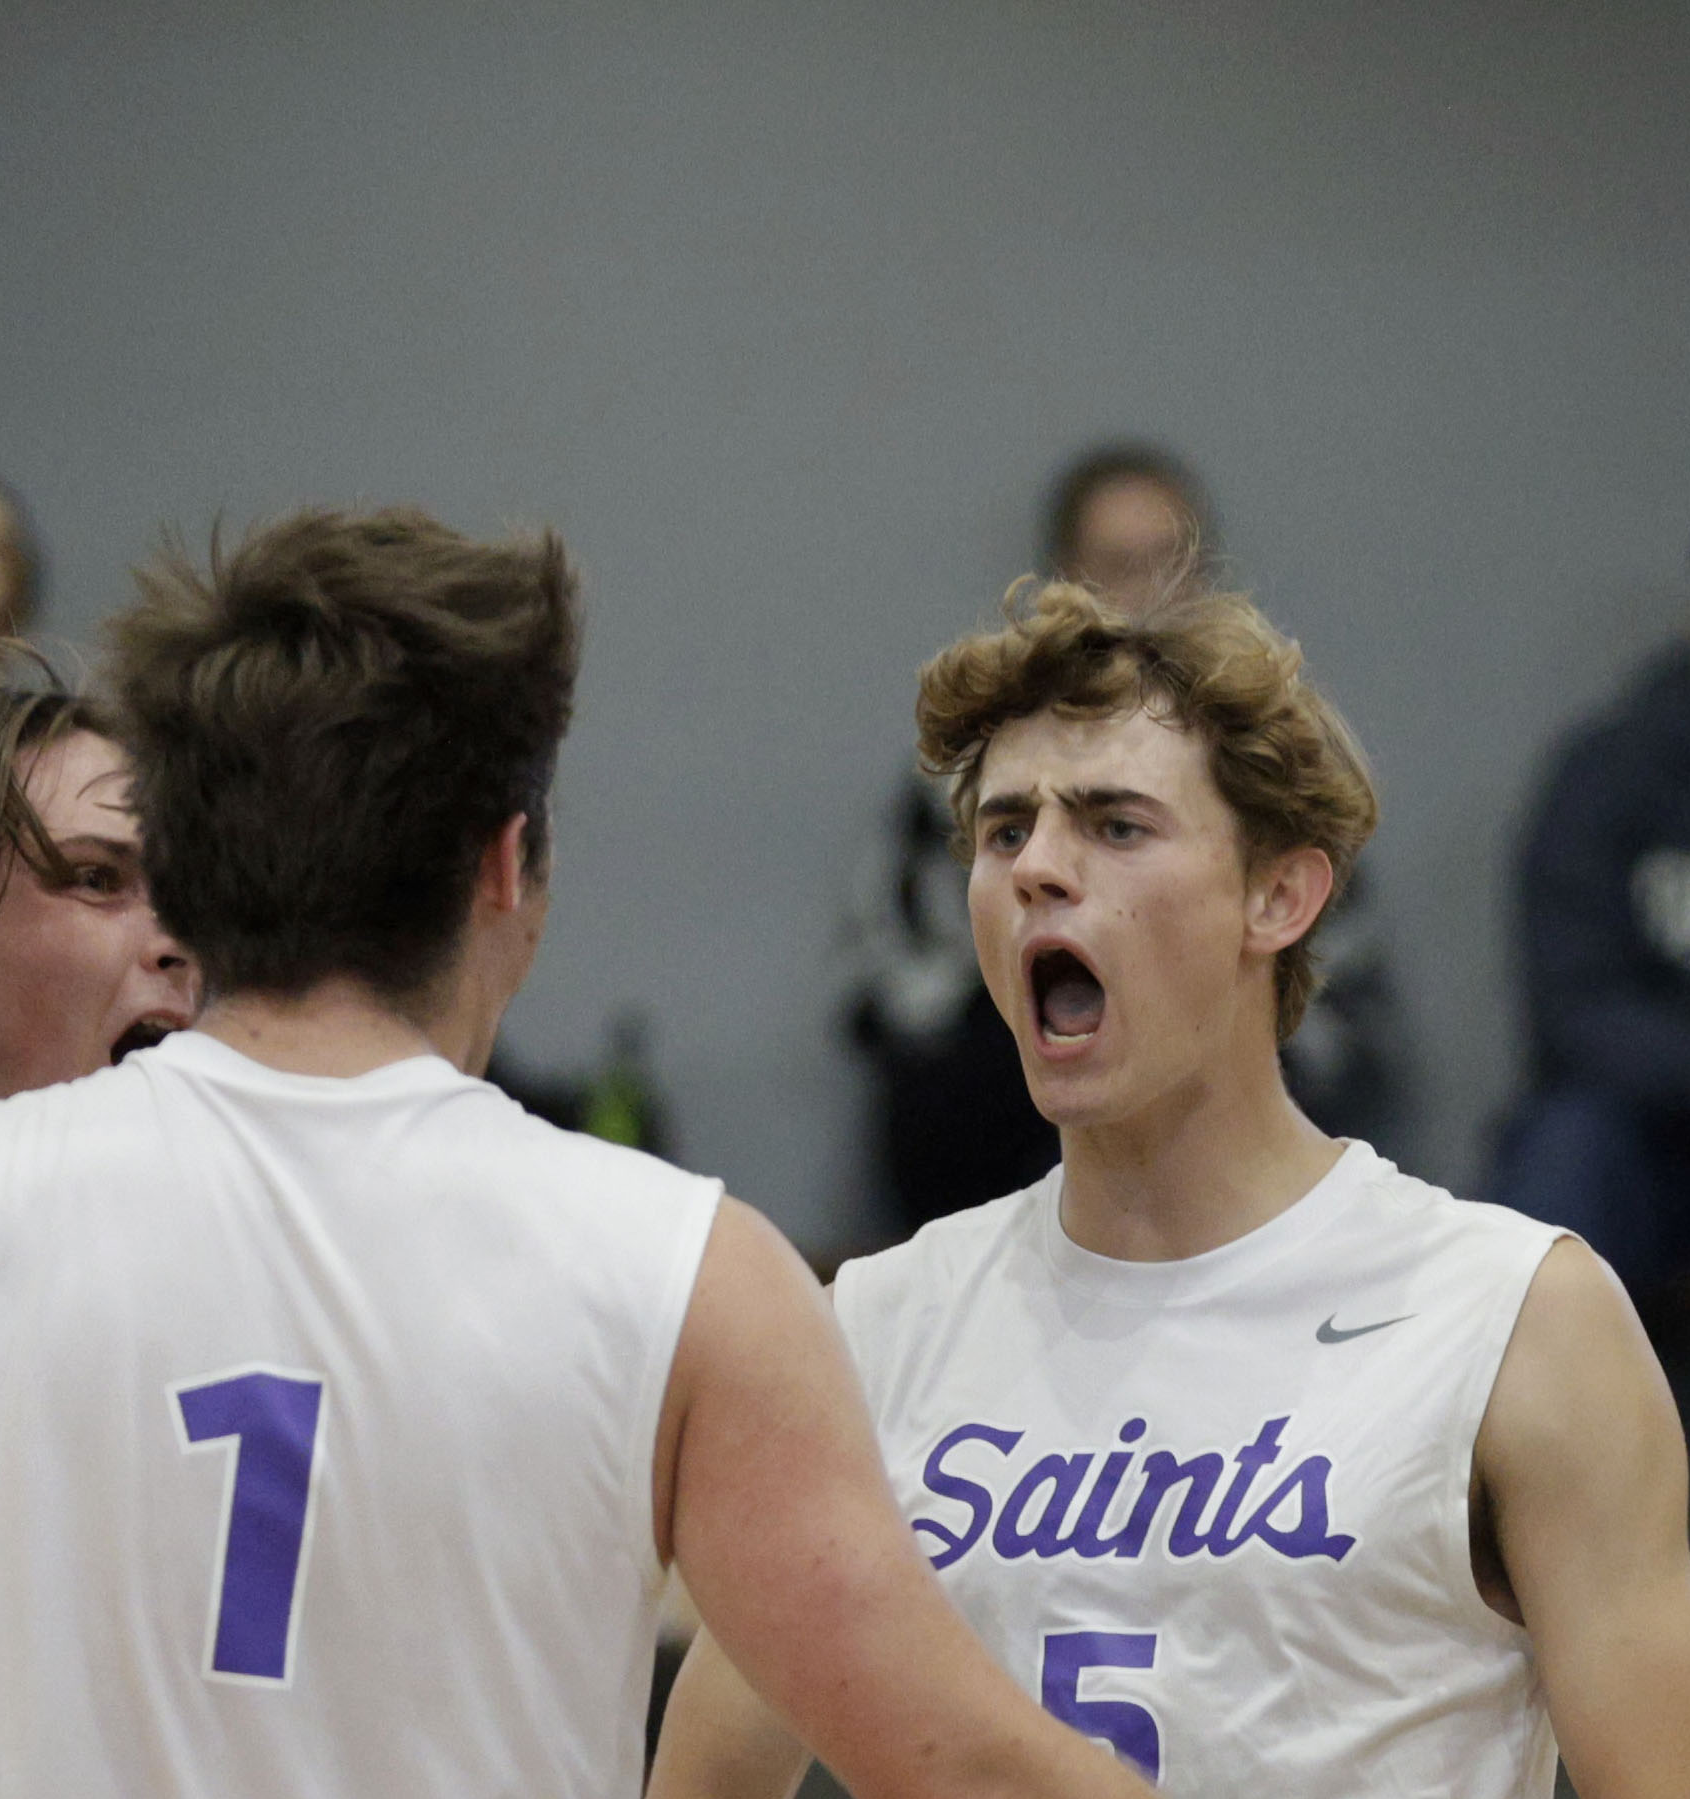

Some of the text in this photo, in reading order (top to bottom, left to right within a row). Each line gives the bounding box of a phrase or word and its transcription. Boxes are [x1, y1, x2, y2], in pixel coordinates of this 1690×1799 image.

[175, 1370, 323, 1680] 1
[911, 1414, 1357, 1571] Saints
[1041, 1629, 1159, 1788] 5
